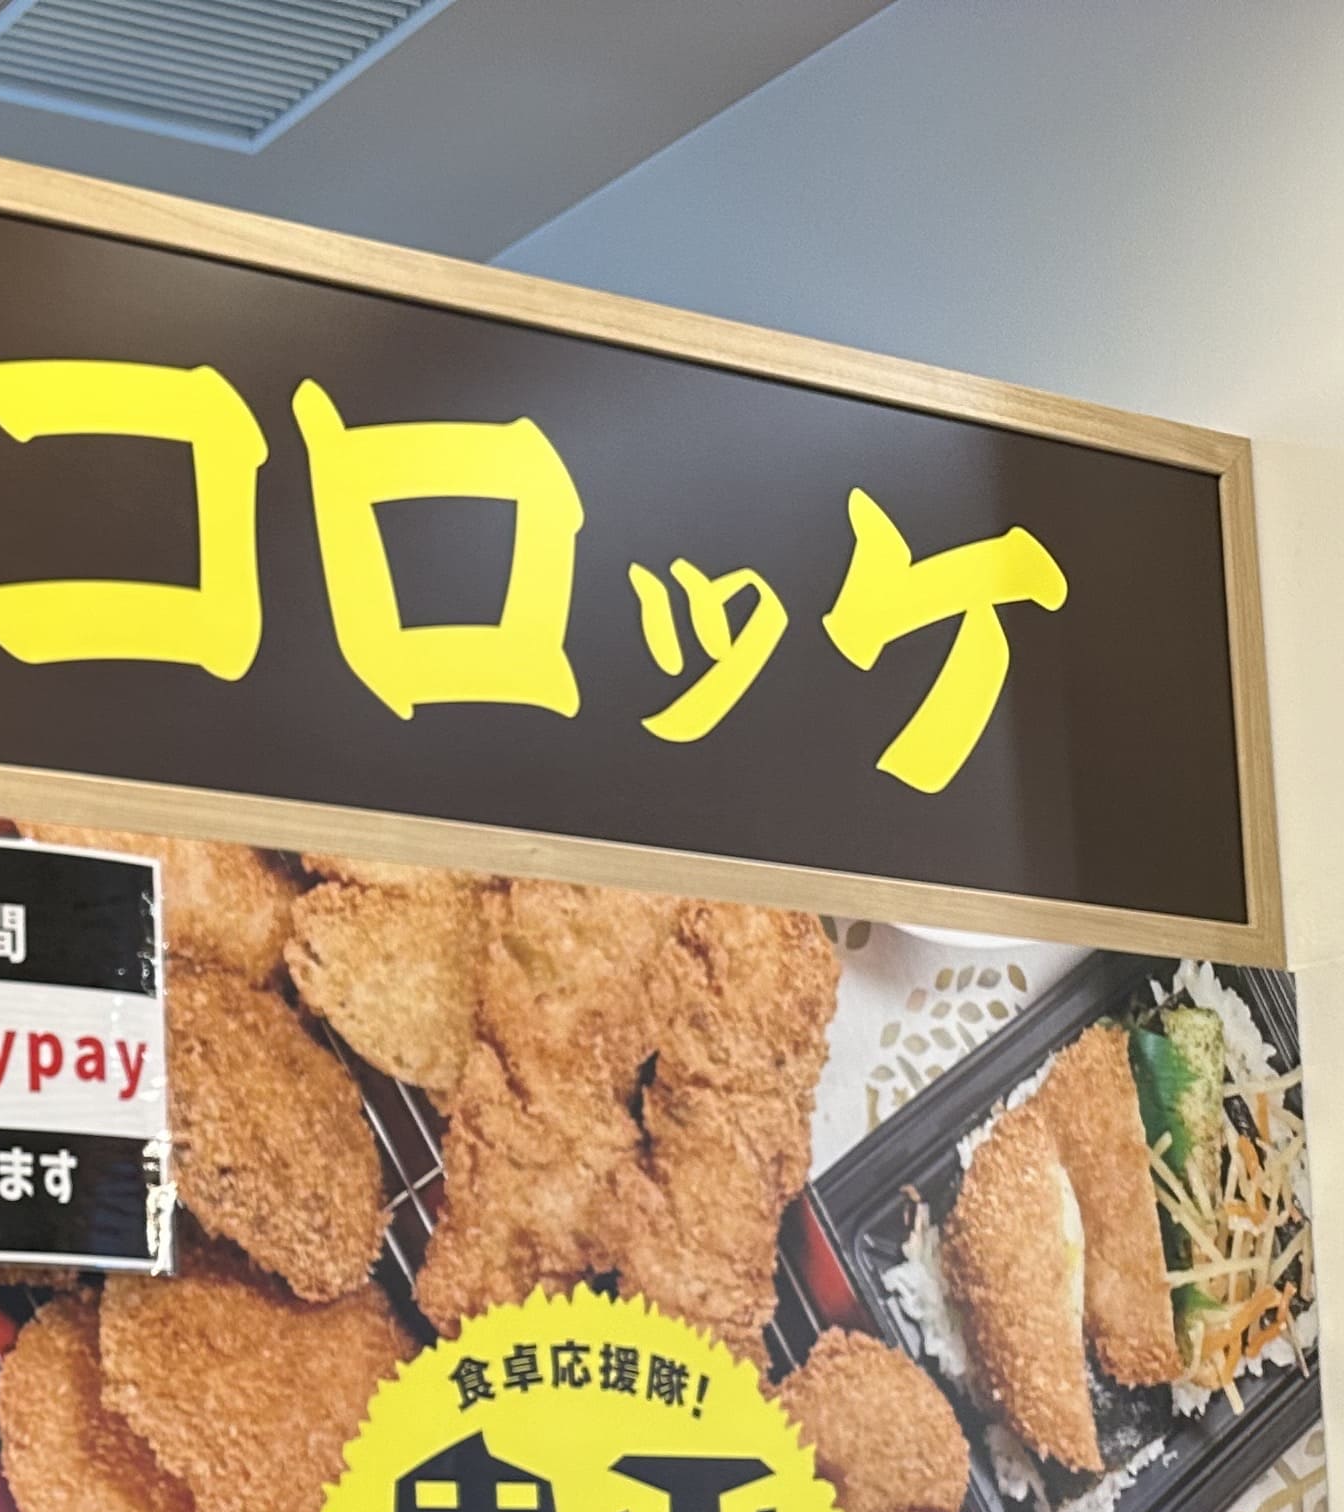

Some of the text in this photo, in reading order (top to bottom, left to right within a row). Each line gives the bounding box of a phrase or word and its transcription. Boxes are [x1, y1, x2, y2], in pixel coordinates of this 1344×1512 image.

[450, 1340, 711, 1420] 食卓応援隊!
